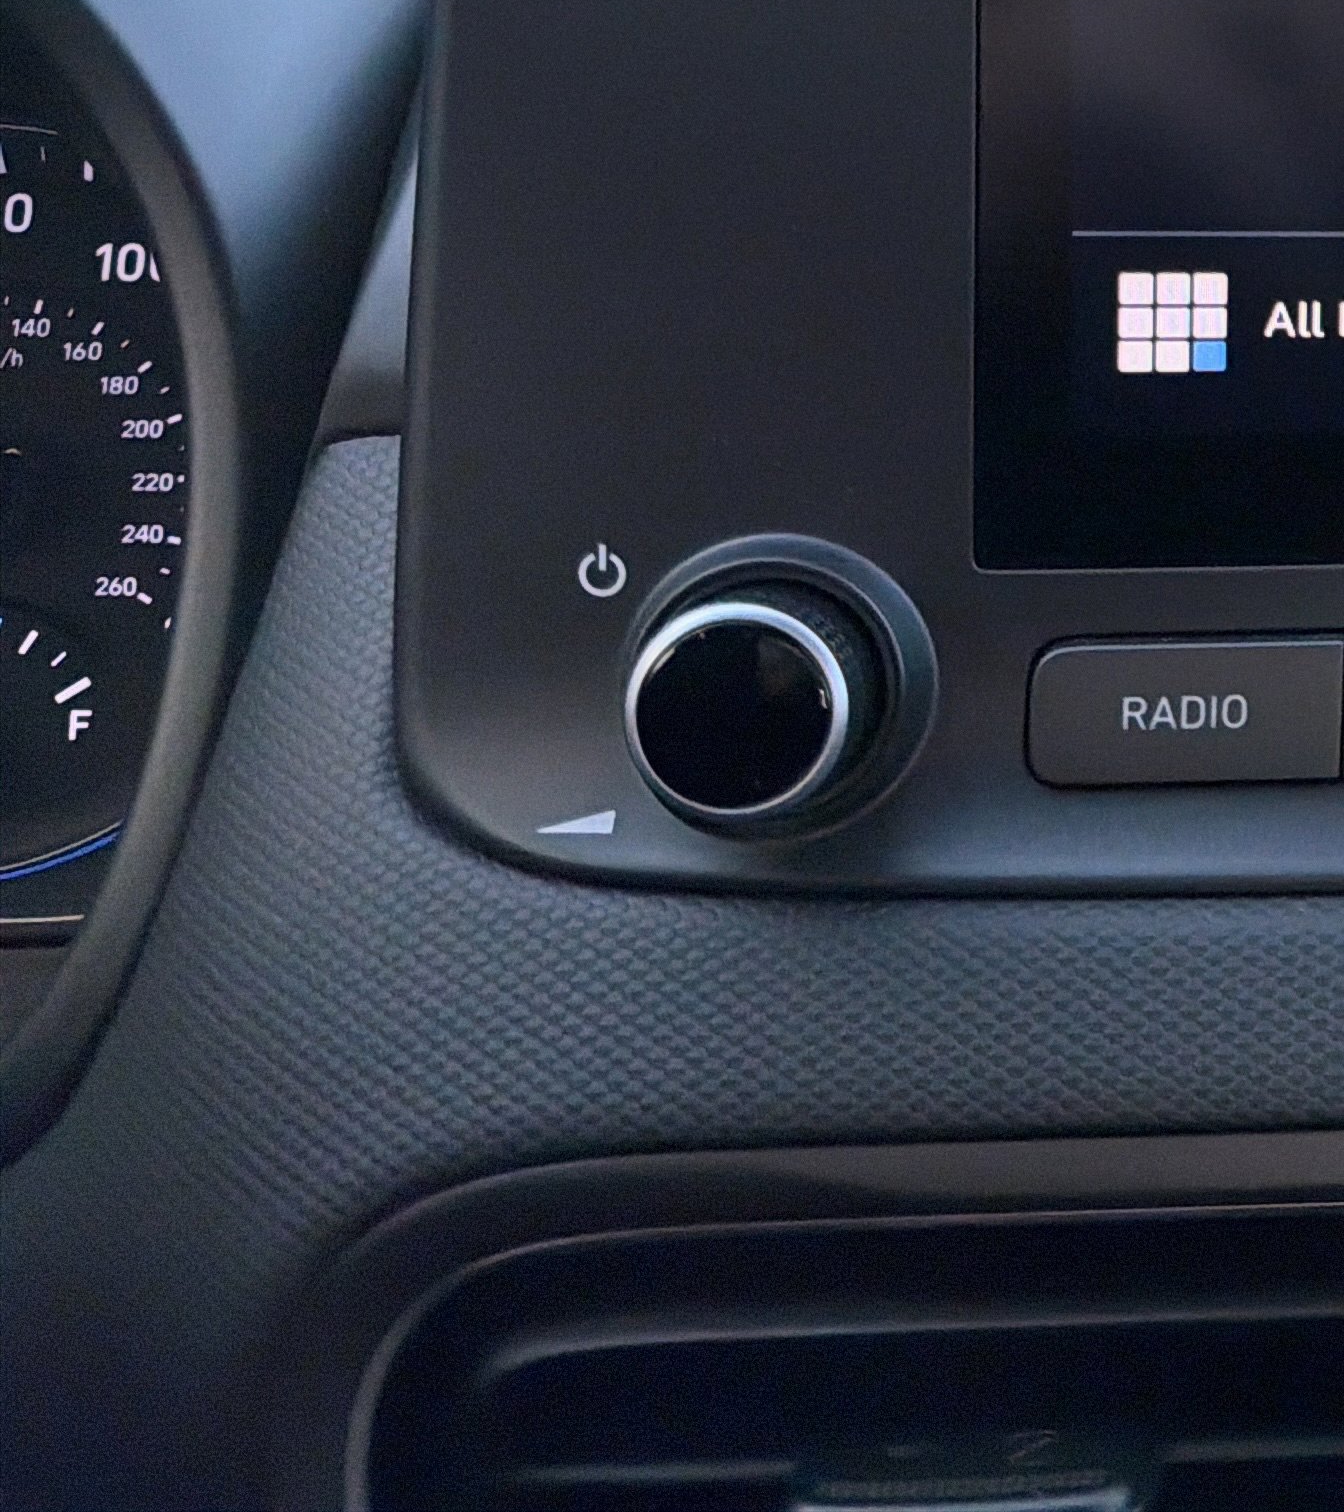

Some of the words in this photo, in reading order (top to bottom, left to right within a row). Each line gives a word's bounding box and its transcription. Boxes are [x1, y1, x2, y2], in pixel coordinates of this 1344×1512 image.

[11, 317, 51, 338] 140
[1263, 300, 1325, 339] All
[63, 341, 103, 361] 160
[100, 375, 139, 395] 180
[120, 419, 164, 439] 200
[131, 472, 174, 492] 220
[121, 524, 164, 544] 240
[94, 576, 138, 597] 260
[1122, 694, 1248, 730] RADIO
[68, 709, 93, 741] F
